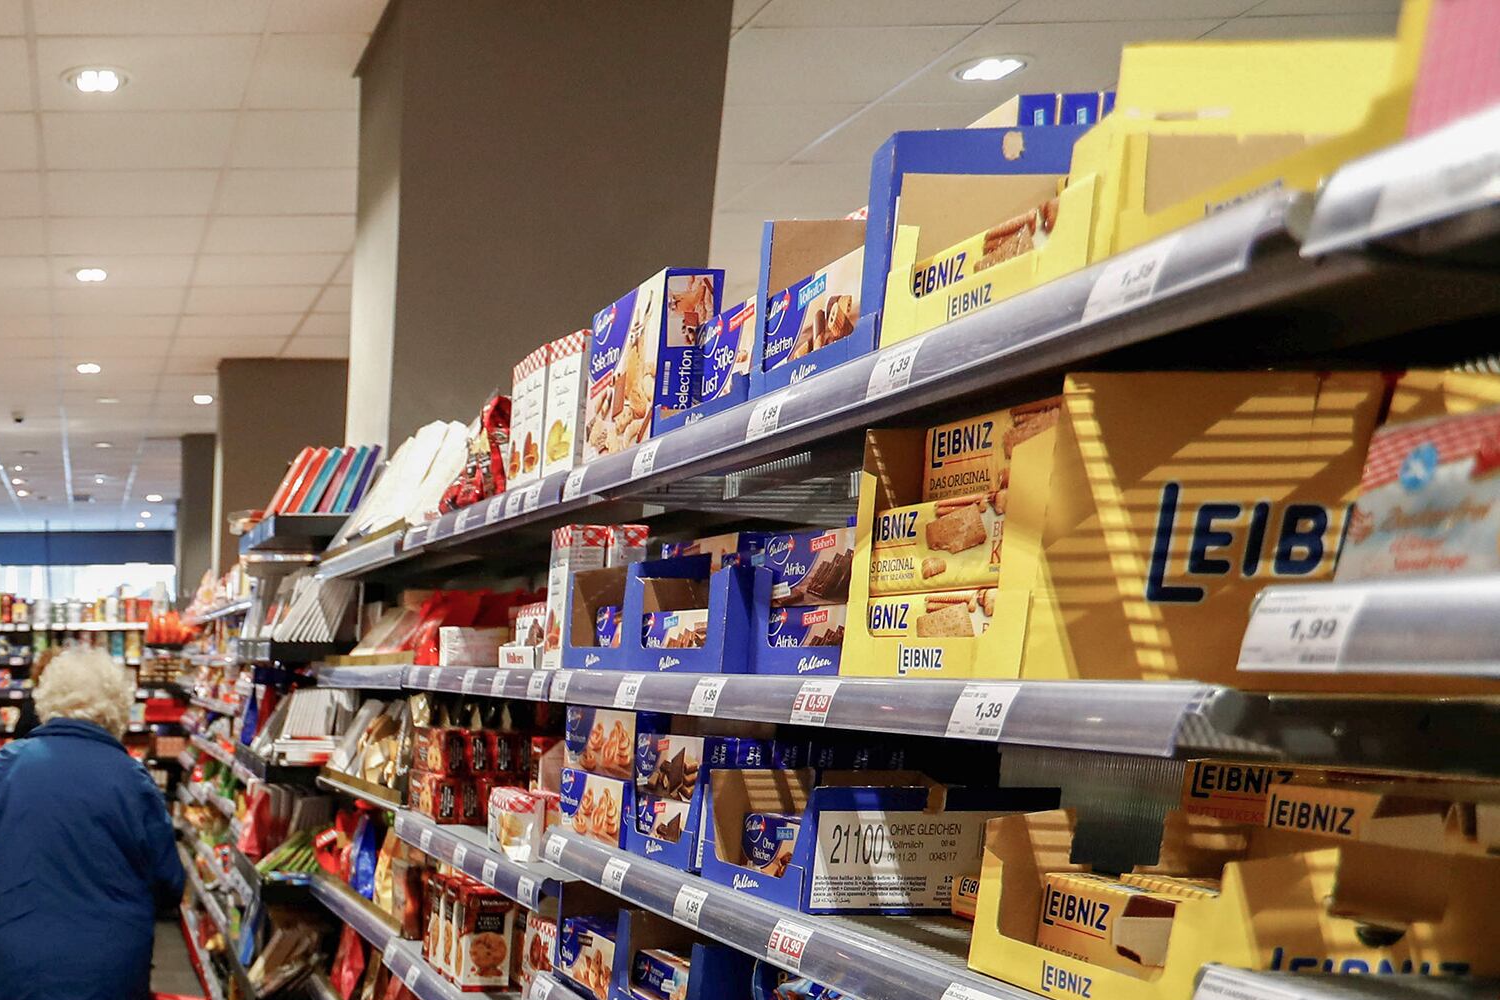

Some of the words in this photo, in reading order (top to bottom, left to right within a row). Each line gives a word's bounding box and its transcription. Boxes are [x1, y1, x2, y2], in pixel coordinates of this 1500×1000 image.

[913, 251, 966, 298] EIBNIZ
[947, 283, 992, 321] LEIBNIZ
[592, 347, 621, 375] Selection
[713, 346, 735, 371] Süße
[887, 355, 911, 377] 1,39
[701, 375, 719, 396] Lust
[762, 406, 778, 422] 1,99
[932, 421, 993, 468] LEIBNIZ
[930, 477, 946, 491] DAS
[948, 469, 990, 488] ORIGINAL
[811, 534, 836, 552] Edelherb
[784, 563, 806, 577] Afrika
[877, 558, 914, 573] ORIGINAL
[803, 610, 828, 626] Edelherb
[1289, 618, 1338, 643] 1,99
[776, 635, 798, 647] Afrika
[798, 656, 832, 673] Bahlsen
[898, 643, 943, 674] LEIBNIZ
[703, 688, 718, 703] 1,99
[808, 694, 829, 712] 0,99
[974, 701, 1003, 720] 1,39
[1268, 793, 1355, 835] LEIBNIZ
[890, 824, 916, 835] OHNE
[917, 823, 961, 836] GLEICHEN
[763, 837, 775, 851] Ohne
[830, 824, 885, 865] 21100
[889, 840, 924, 849] Vollmilch
[752, 847, 771, 861] Gleichen
[611, 869, 623, 883] 1,99
[733, 873, 760, 889] Bahlsen
[685, 900, 700, 917] 1,99
[1042, 883, 1110, 931] LEIBNIZ
[780, 937, 802, 956] 0,99
[1040, 960, 1092, 998] LEIBNIZ
